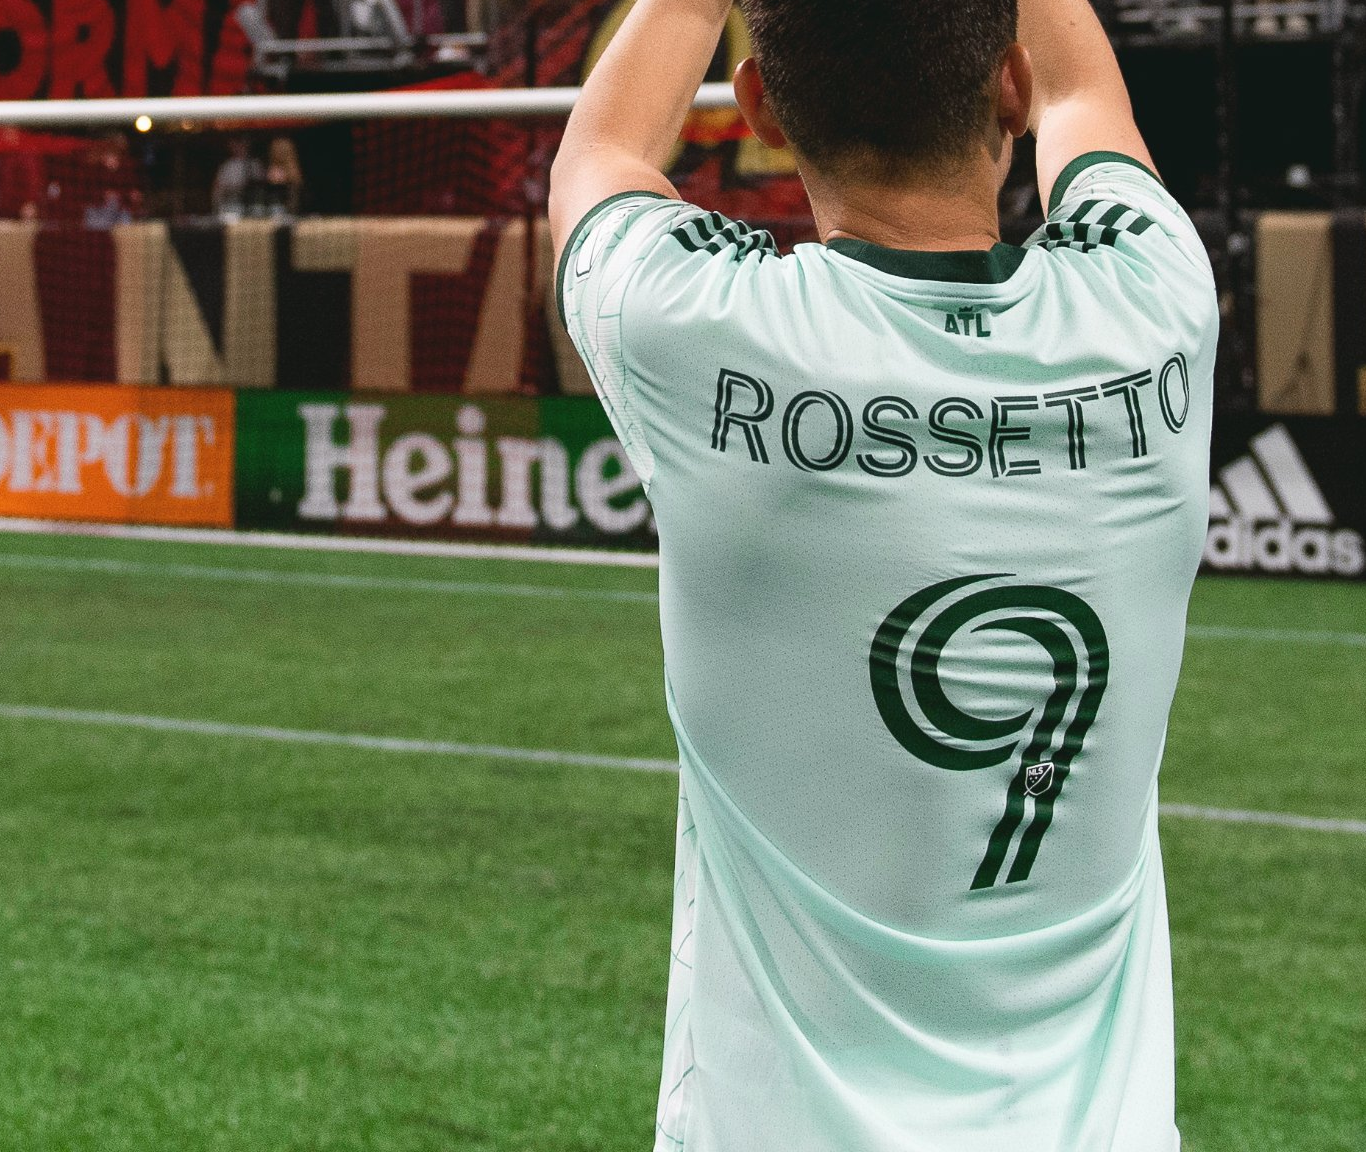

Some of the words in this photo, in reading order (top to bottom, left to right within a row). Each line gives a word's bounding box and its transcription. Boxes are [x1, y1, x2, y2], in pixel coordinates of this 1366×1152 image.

[944, 311, 992, 338] ATL
[710, 352, 1191, 479] ROSSETTO
[296, 402, 657, 533] Heine
[1206, 517, 1366, 576] didas
[869, 573, 1110, 890] 9
[1028, 766, 1044, 777] MLS
